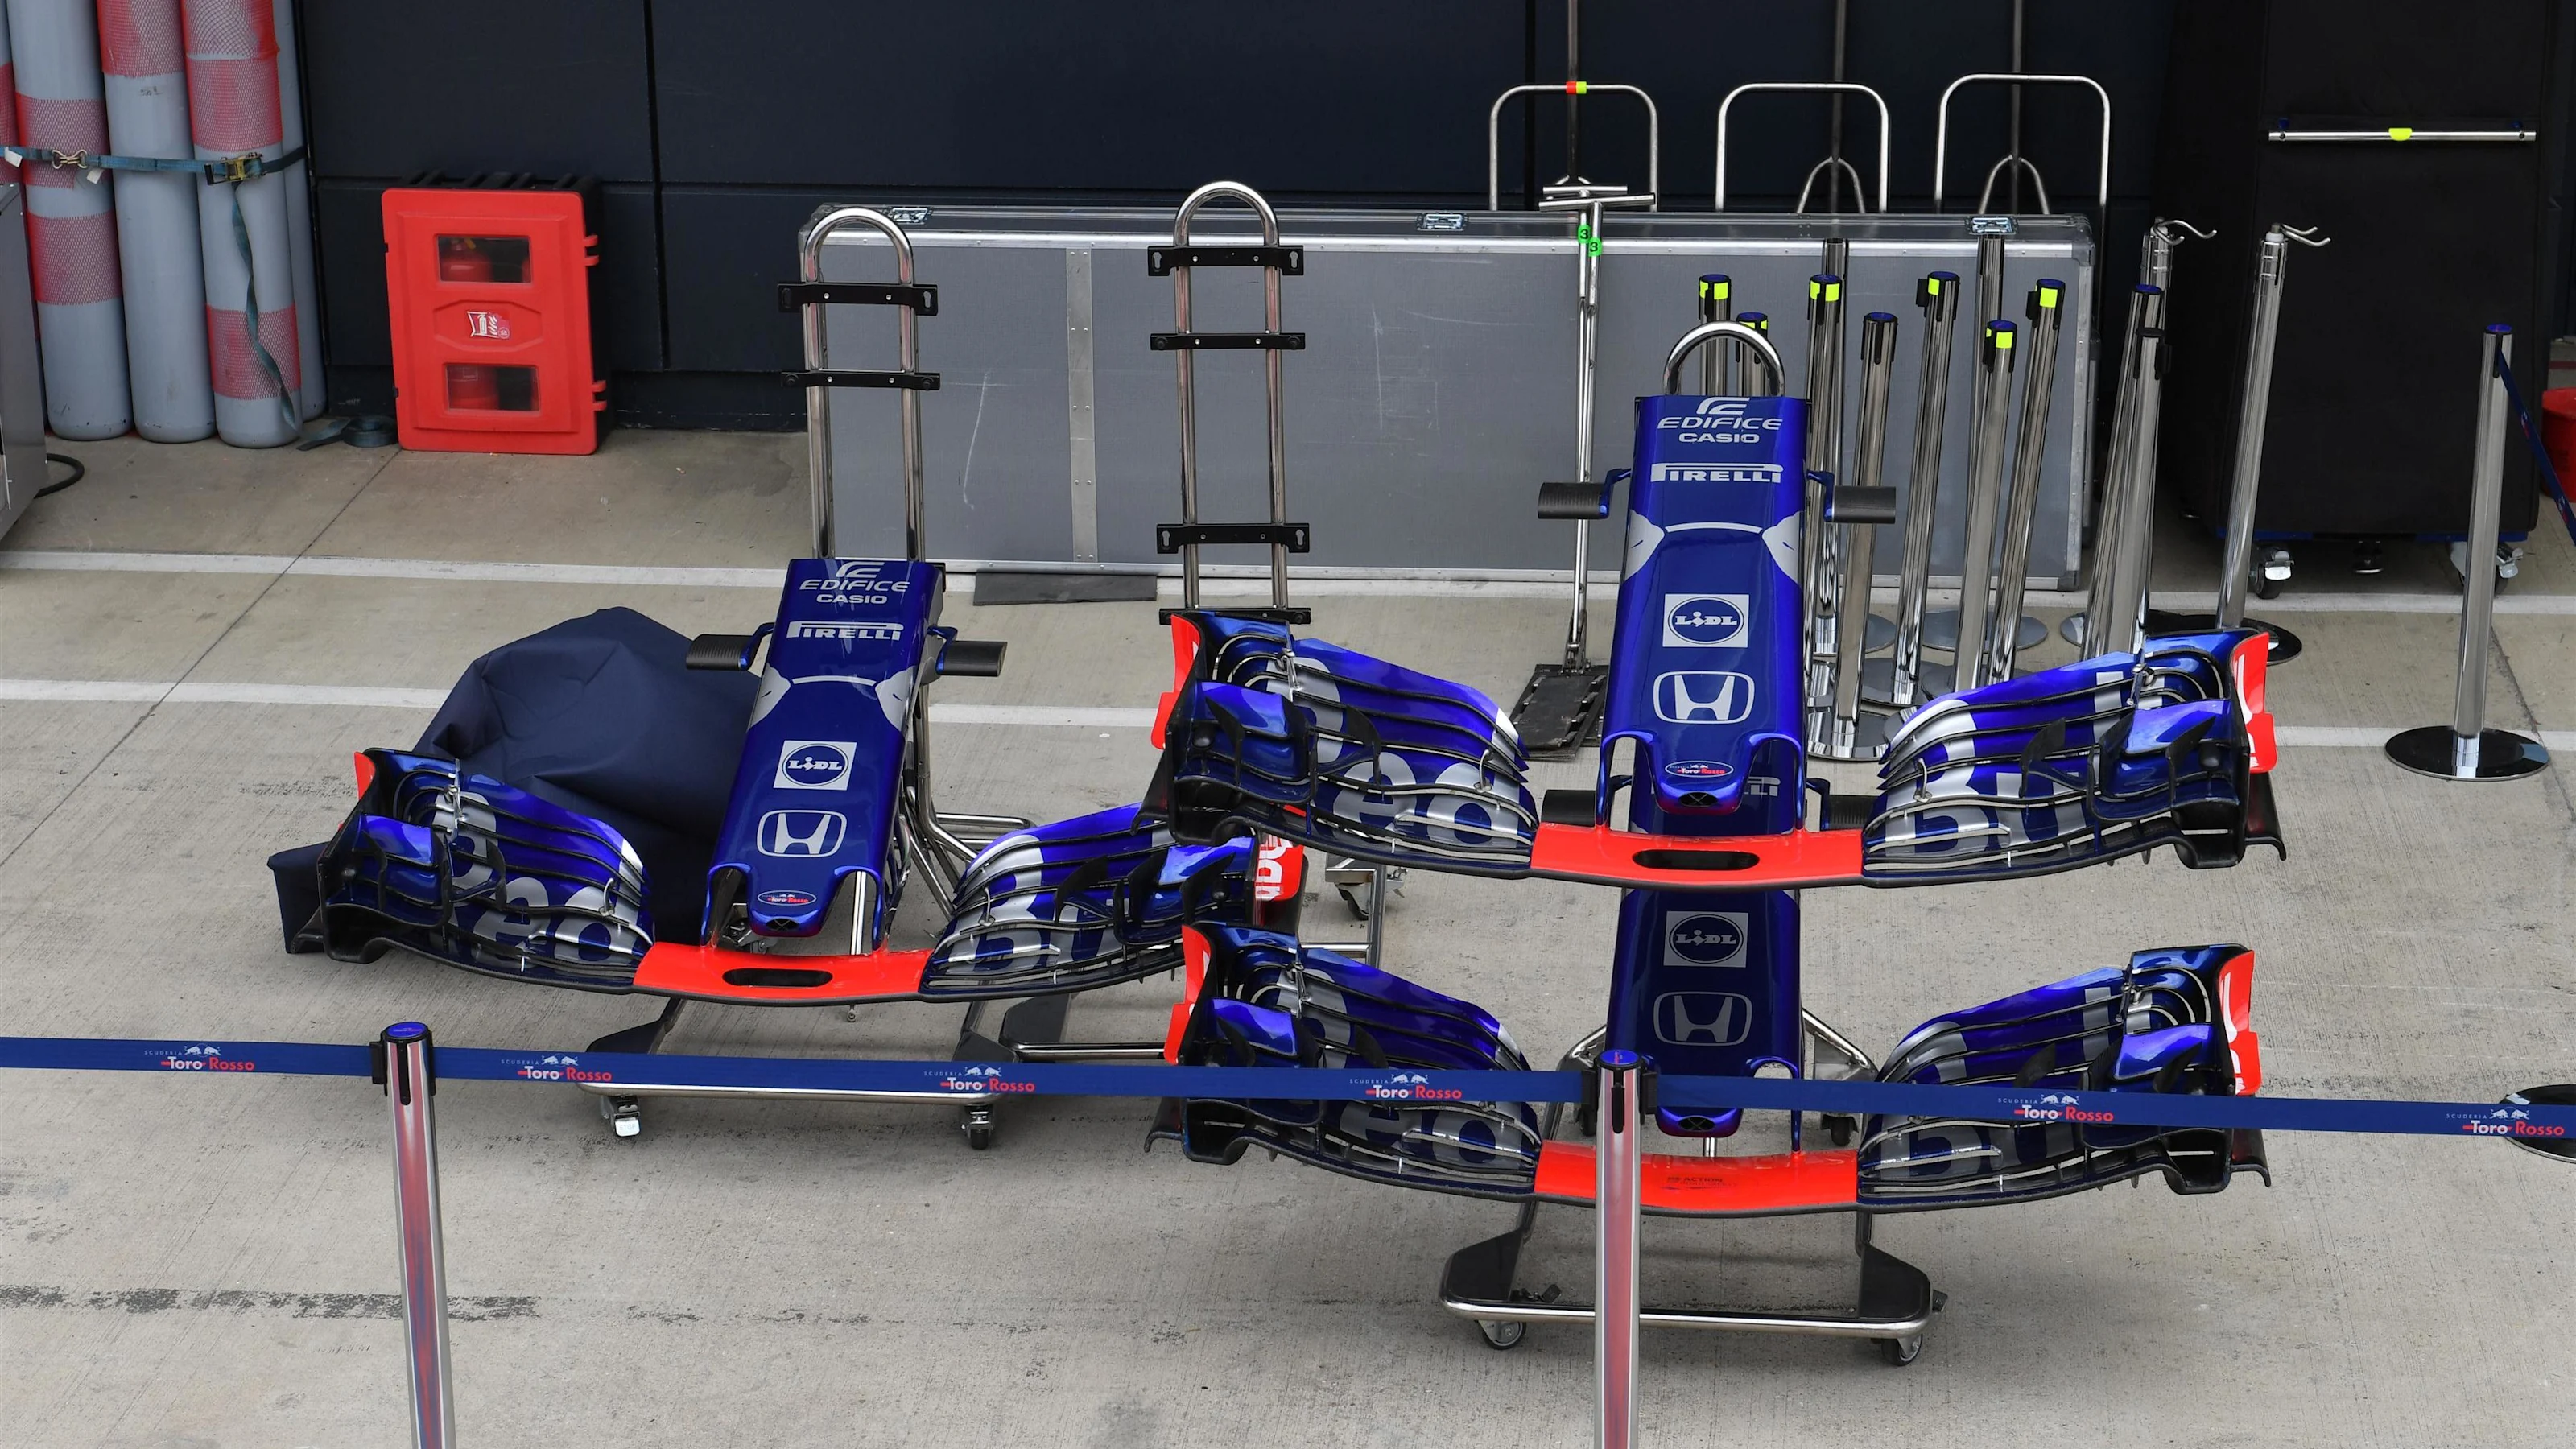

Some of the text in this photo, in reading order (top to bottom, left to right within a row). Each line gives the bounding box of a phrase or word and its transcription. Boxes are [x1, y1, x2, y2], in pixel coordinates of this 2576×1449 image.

[1580, 229, 1589, 239] 3
[1590, 242, 1599, 252] 3
[1657, 417, 1783, 430] EDIFICE
[1678, 433, 1761, 443] CASIO
[1650, 463, 1784, 483] PIRELLI
[799, 579, 910, 592] EDIFICE
[816, 594, 888, 604] CASIO
[786, 621, 905, 641] PIRELLI
[167, 1055, 255, 1071] Toro Rosso
[524, 1065, 613, 1081] Toro Rosso
[947, 1076, 1035, 1092] Toro Rosso
[1373, 1084, 1463, 1100] Toro Rosso
[2021, 1104, 2114, 1121] Toro Rosso
[2471, 1120, 2565, 1136] Toro Rosso
